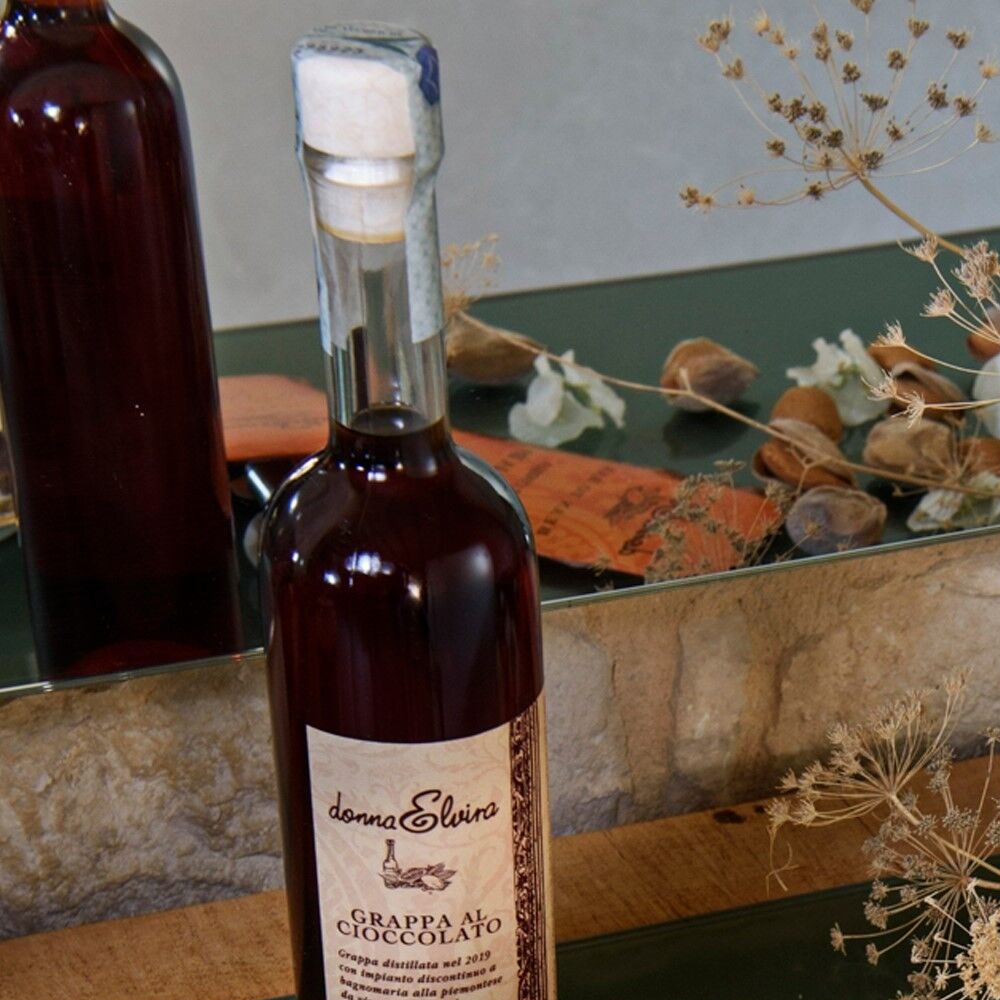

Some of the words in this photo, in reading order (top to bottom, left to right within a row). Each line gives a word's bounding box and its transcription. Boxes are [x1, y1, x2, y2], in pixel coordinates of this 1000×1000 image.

[329, 791, 397, 830] donna
[399, 789, 499, 833] Elvira
[350, 908, 452, 929] GRAPPA
[461, 909, 488, 925] AL
[336, 917, 502, 946] CIOCCOLATO
[338, 949, 378, 966] Grappa
[383, 959, 438, 969] distillata
[443, 957, 461, 967] nel
[465, 951, 491, 965] 2019
[339, 964, 357, 975] con
[361, 970, 414, 983] impianto
[417, 968, 486, 983] discontinuo
[489, 964, 496, 972] a
[340, 976, 408, 997] bagnomaria
[412, 988, 437, 997] alla
[441, 975, 503, 998] piemontese
[341, 991, 353, 1000] da
